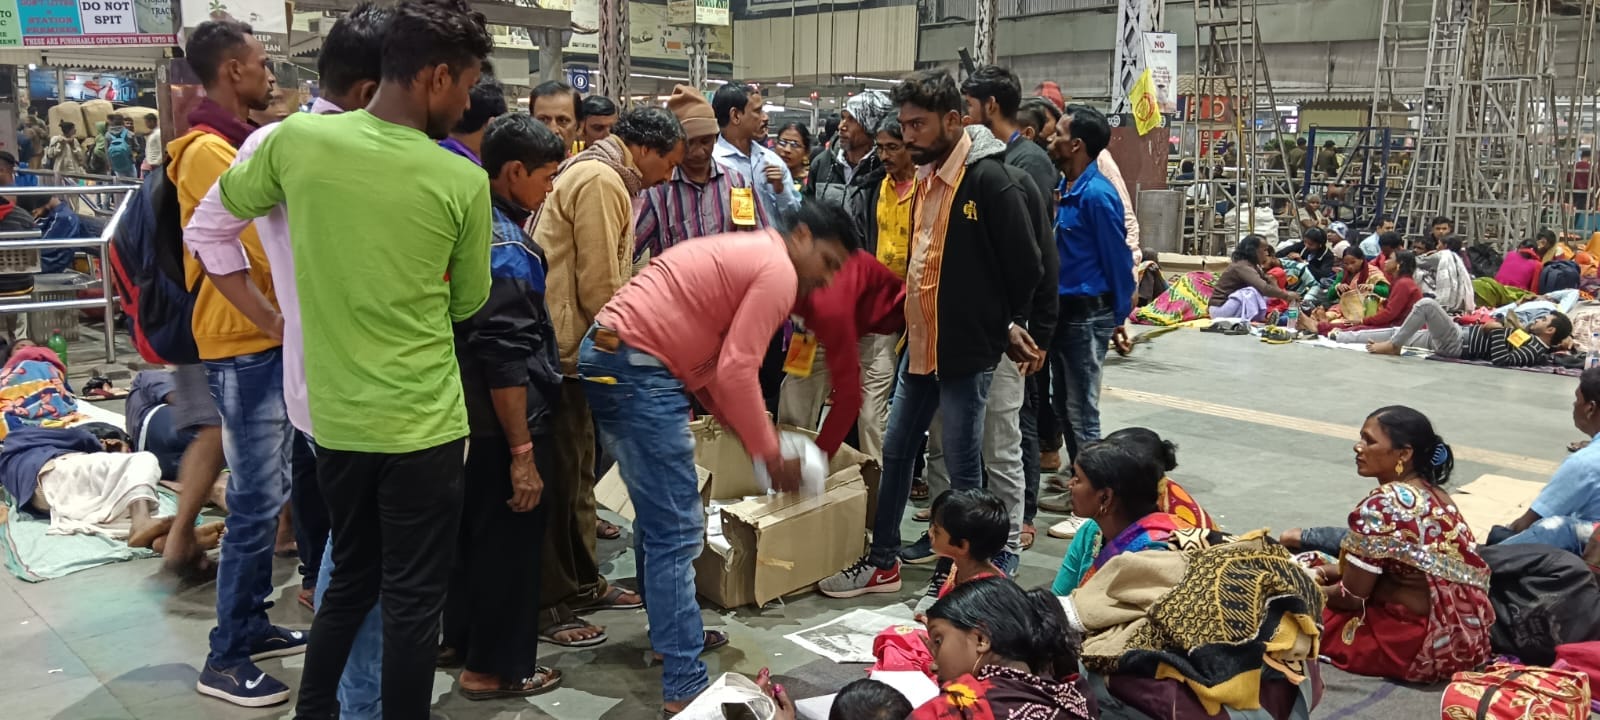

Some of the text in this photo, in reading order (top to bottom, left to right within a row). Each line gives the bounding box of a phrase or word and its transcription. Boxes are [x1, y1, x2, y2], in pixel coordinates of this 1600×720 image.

[82, 2, 130, 11] DO NOT
[94, 15, 122, 24] SPIT
[59, 37, 95, 45] PUNISHABLE
[577, 77, 584, 86] 9
